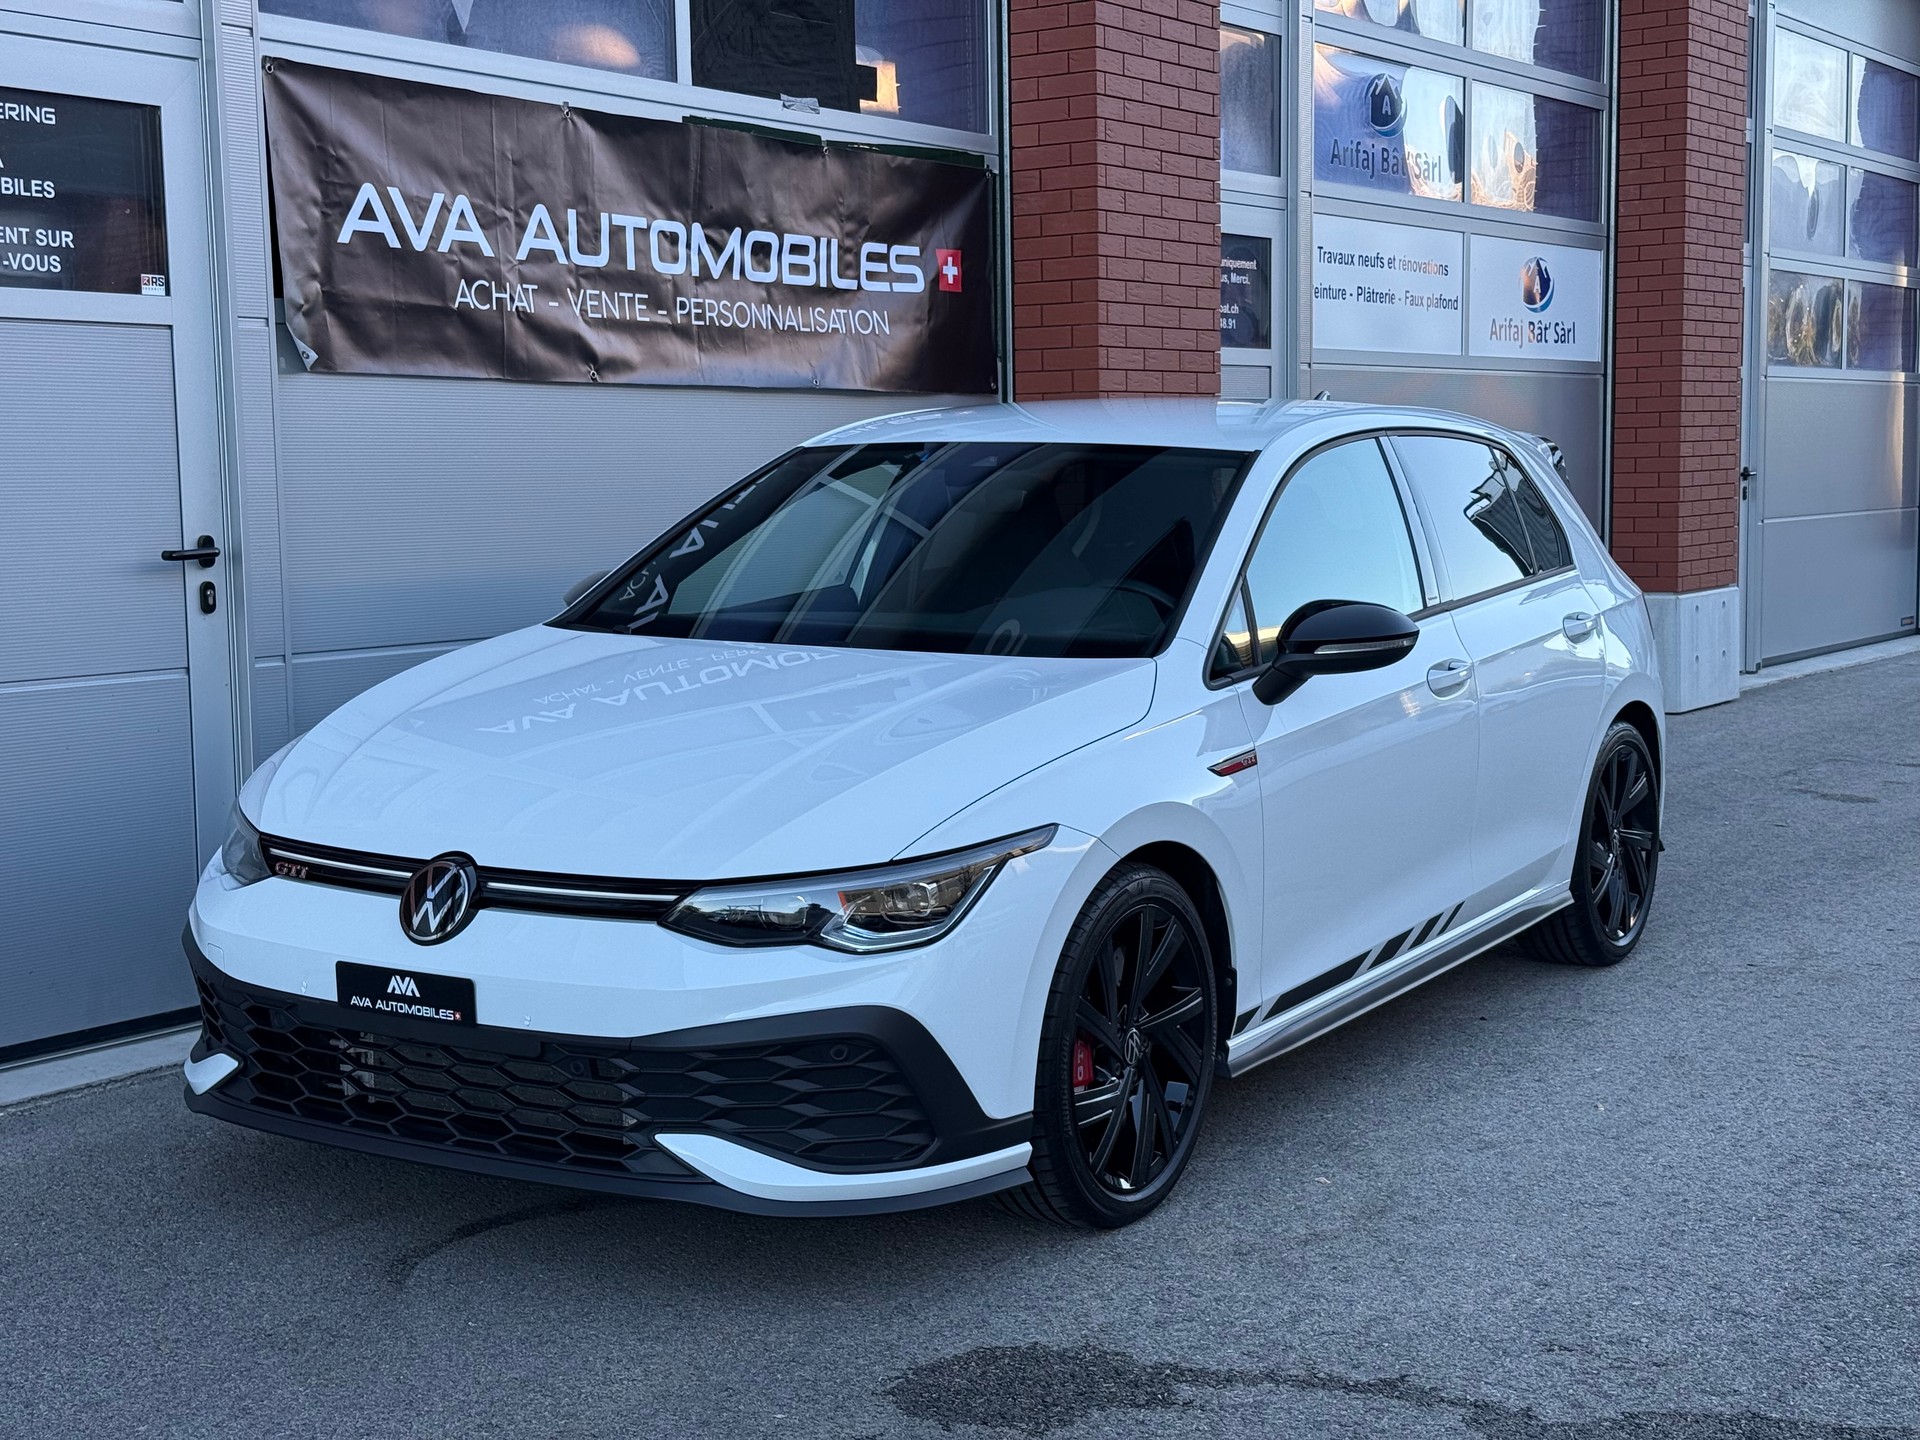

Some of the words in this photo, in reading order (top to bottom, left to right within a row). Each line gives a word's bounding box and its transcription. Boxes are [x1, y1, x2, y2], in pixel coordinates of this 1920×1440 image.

[1330, 138, 1375, 179] Arifaj
[1, 176, 56, 199] BILES
[35, 228, 75, 249] SUR
[336, 182, 495, 258] AVA
[515, 203, 926, 293] AUTOMOBILES
[1317, 246, 1355, 267] Travaux
[1358, 252, 1385, 269] neufs
[1387, 256, 1396, 270] et
[1398, 254, 1449, 276] rénovations
[454, 278, 539, 314] ACHAT
[566, 287, 650, 323] VENTE
[676, 296, 891, 336] PERSONNALISATION
[1312, 282, 1347, 301] einture
[1356, 286, 1396, 305] Plâtrerie
[1404, 290, 1425, 308] Faux
[1426, 293, 1459, 312] plafond
[1489, 317, 1524, 349] Arifaj
[1553, 321, 1576, 344] Sàrl
[387, 975, 421, 998] AVA
[350, 995, 373, 1009] AVA
[375, 999, 454, 1021] AUTOMOBILES
